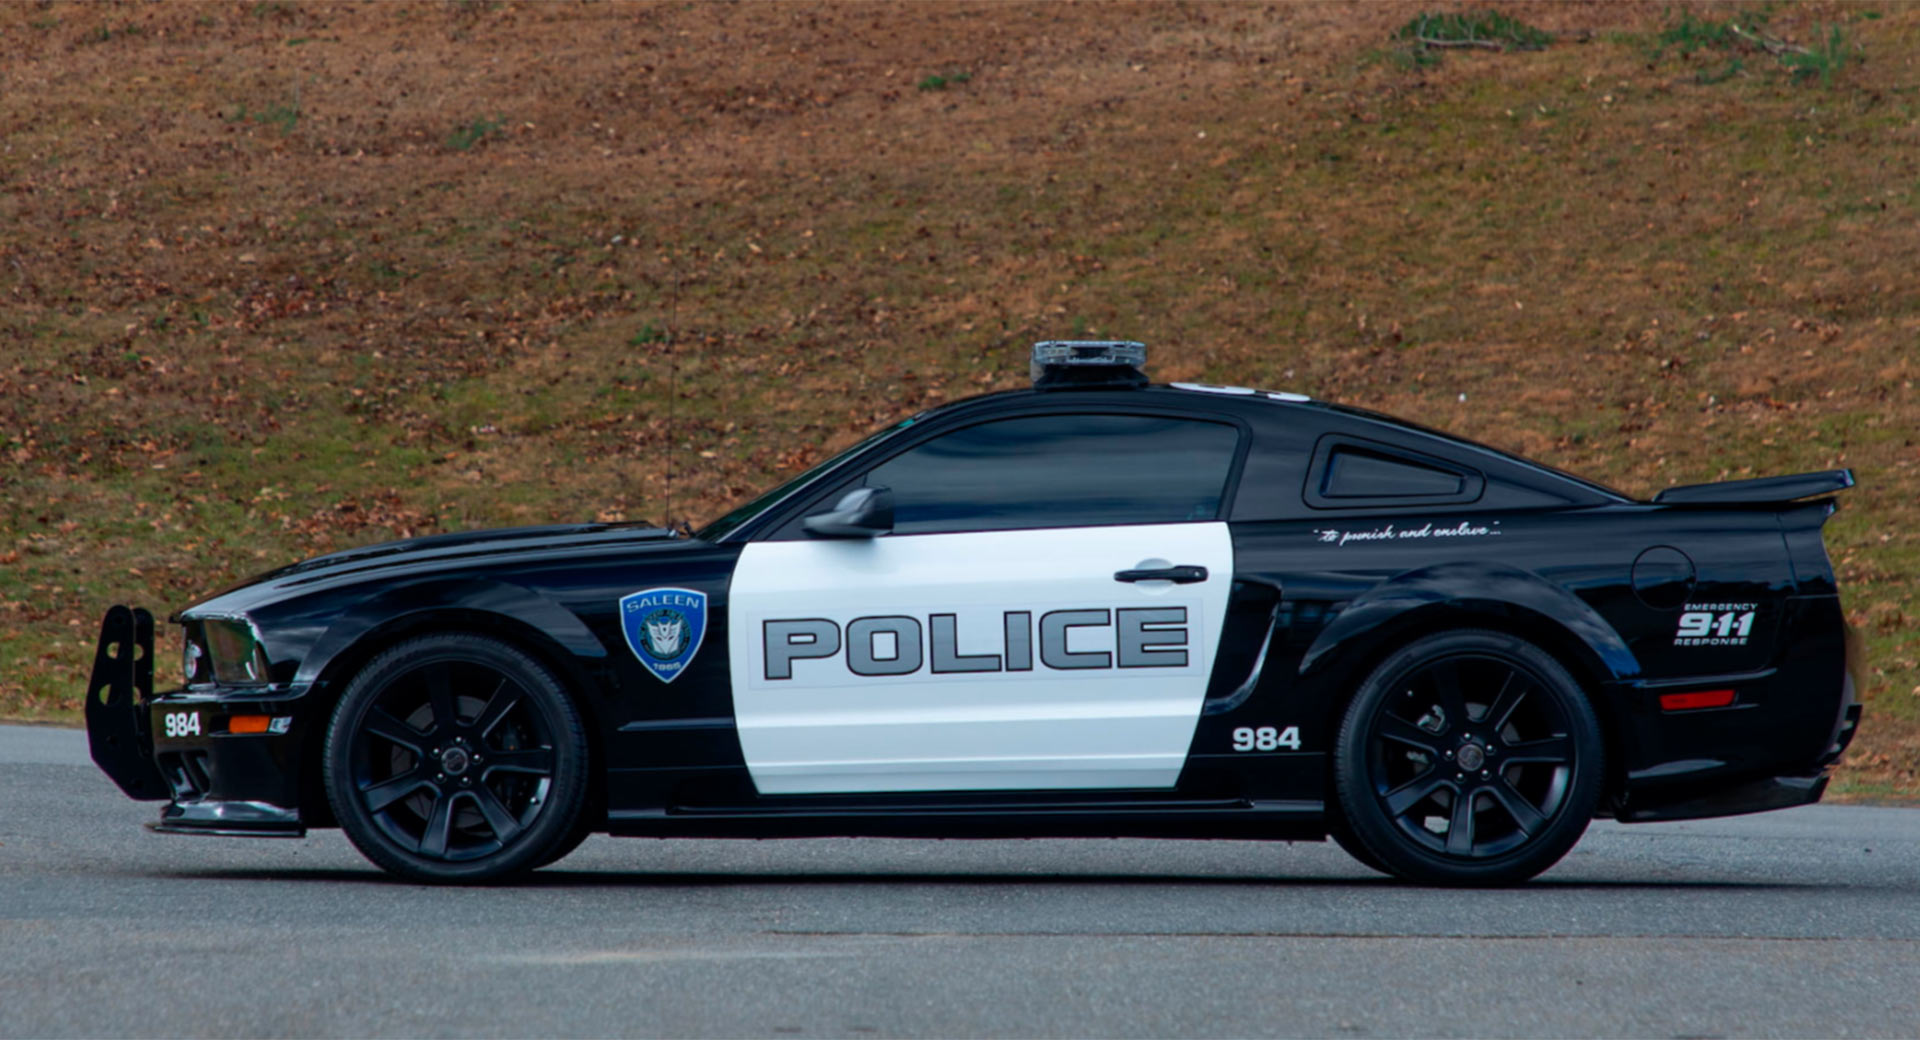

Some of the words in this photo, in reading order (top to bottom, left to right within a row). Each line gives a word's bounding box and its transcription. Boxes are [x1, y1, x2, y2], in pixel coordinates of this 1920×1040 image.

[1338, 524, 1396, 546] punish
[1399, 523, 1433, 538] and
[626, 594, 700, 613] SALEEN
[1683, 603, 1758, 611] EMERGENCY
[762, 606, 1189, 681] POLICE
[1673, 637, 1748, 646] RESPONSE
[165, 711, 201, 737] 984
[1232, 726, 1302, 752] 984
